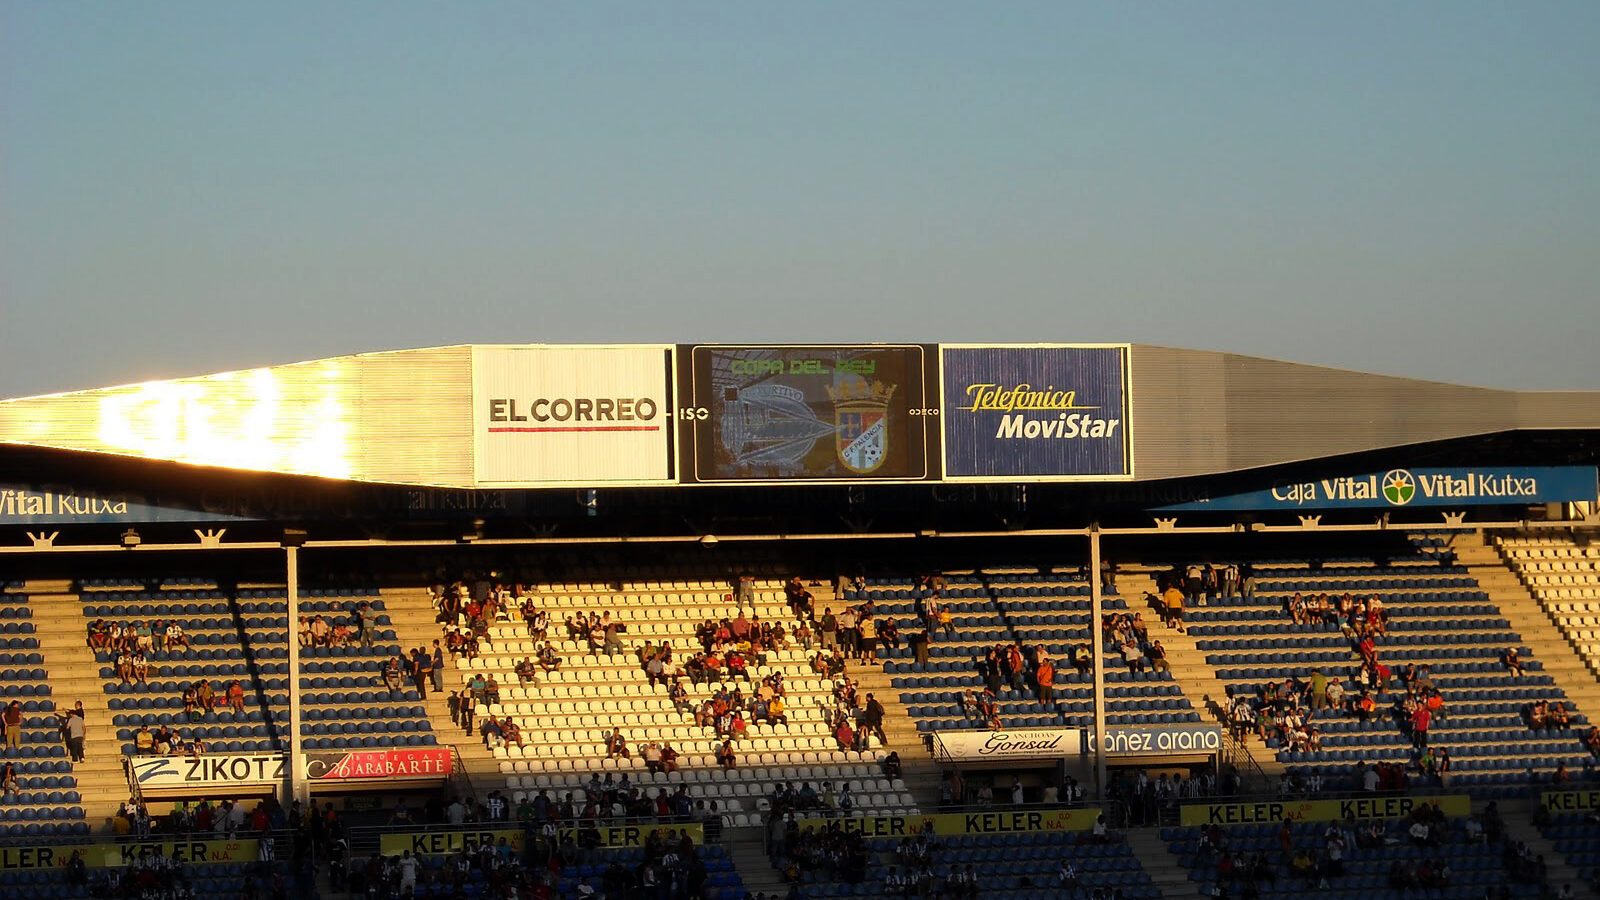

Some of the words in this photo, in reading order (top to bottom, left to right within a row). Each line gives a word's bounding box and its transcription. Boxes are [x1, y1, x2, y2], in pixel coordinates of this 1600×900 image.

[732, 359, 784, 374] COPA
[790, 359, 830, 374] DEL
[835, 359, 876, 374] REY
[489, 398, 527, 422] EL
[530, 397, 657, 422] CORREO
[996, 412, 1119, 439] MoviStar
[1271, 482, 1316, 505] Caja
[1321, 475, 1378, 500] Vital
[1418, 473, 1476, 497] Vital
[1478, 474, 1537, 496] Kutxa
[978, 733, 1063, 754] Gonsal
[1157, 730, 1219, 750] arana
[184, 757, 289, 781] ZIKOTZ
[354, 759, 445, 776] ARABARTE
[1209, 804, 1283, 823] KELER
[1341, 799, 1413, 818] KELER
[827, 817, 905, 836] KELER
[965, 812, 1042, 833] KELER
